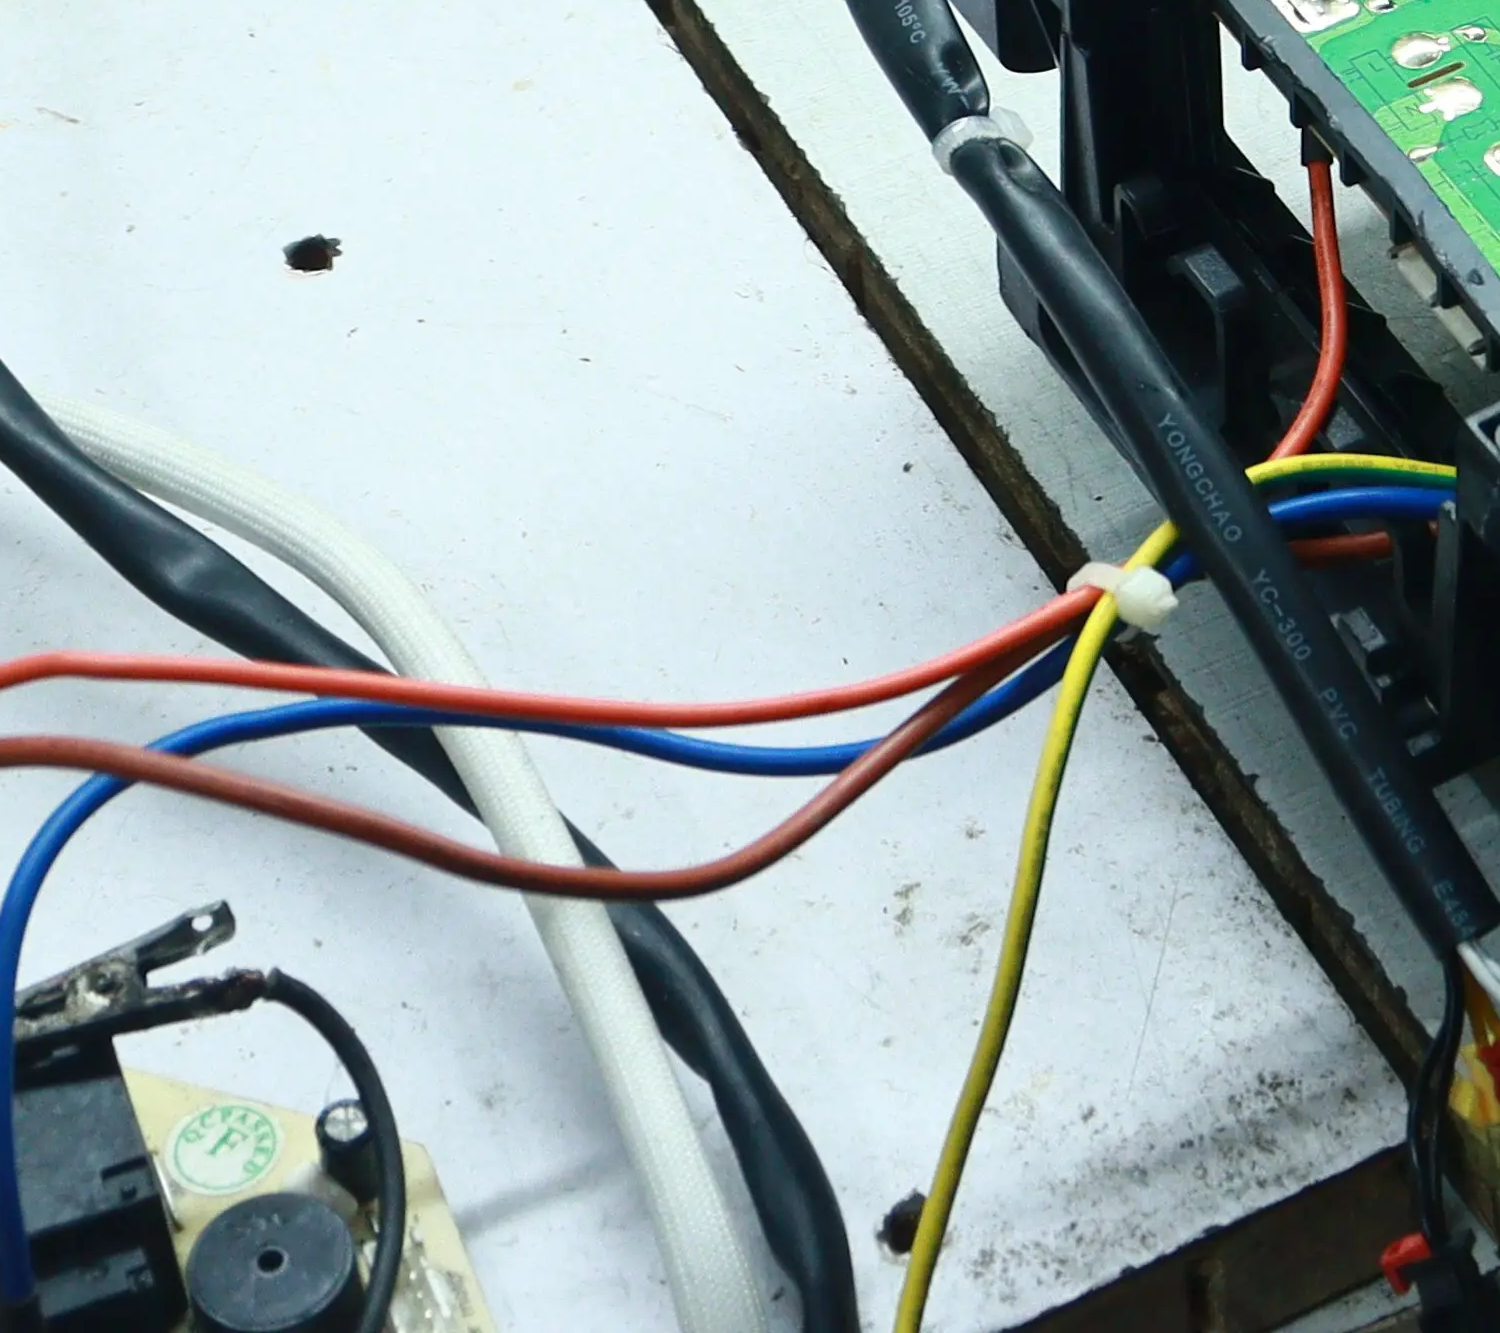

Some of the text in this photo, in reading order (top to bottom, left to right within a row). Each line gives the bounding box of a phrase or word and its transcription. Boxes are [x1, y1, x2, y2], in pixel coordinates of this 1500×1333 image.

[1155, 410, 1244, 545] YONGCHAO
[1250, 567, 1313, 663] YC-300
[1320, 686, 1359, 742] PVC
[1365, 765, 1426, 856] TUBING
